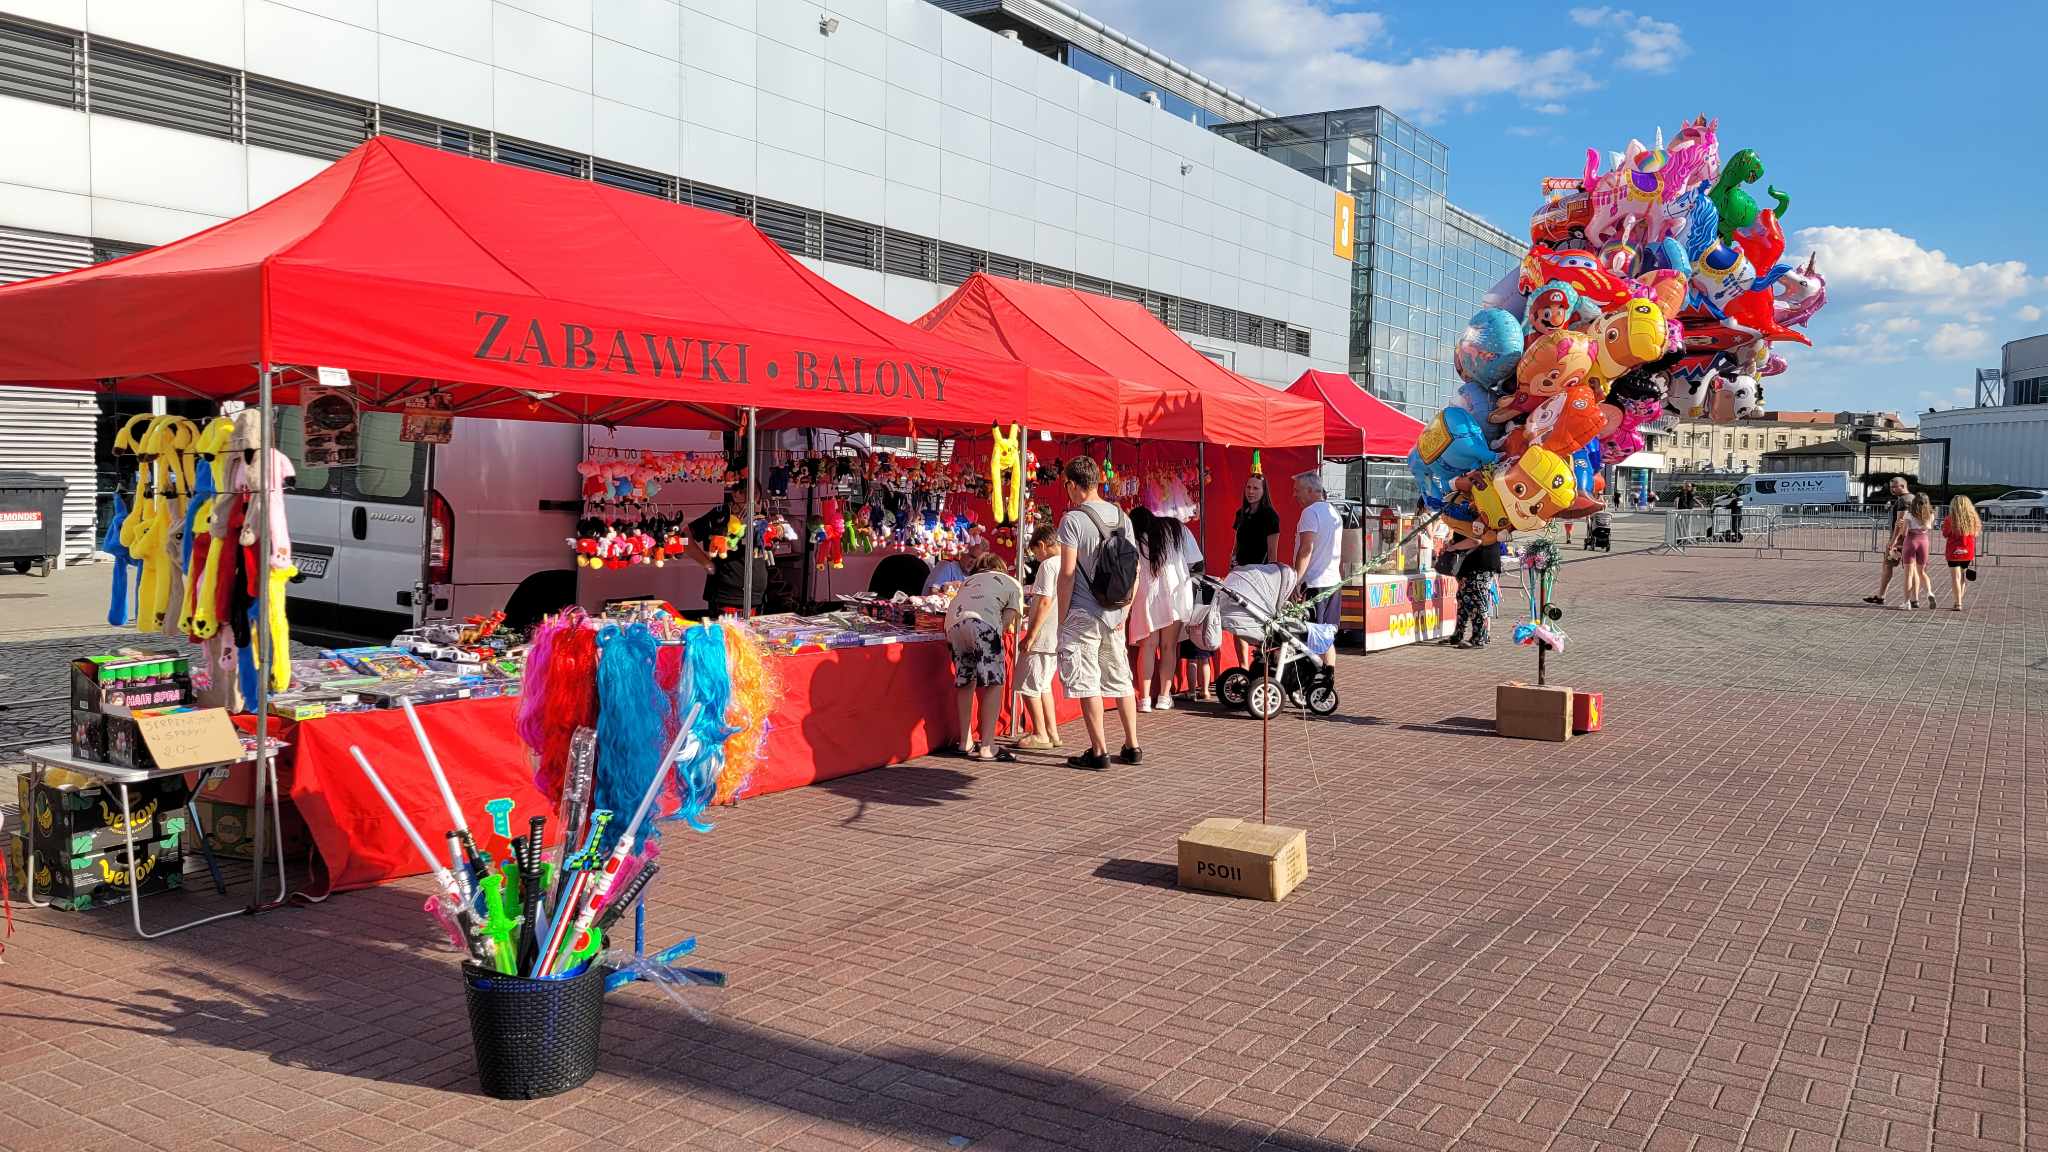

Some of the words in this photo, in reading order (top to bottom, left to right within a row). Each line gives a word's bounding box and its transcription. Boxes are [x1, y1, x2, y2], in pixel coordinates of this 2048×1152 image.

[1342, 205, 1349, 247] 3
[473, 310, 751, 385] ZABAWKI
[794, 350, 952, 402] BALONY
[0, 512, 41, 521] EMONDIS
[1369, 583, 1404, 608] WATA
[1389, 607, 1440, 637] POPCORN
[126, 693, 152, 707] HAIR
